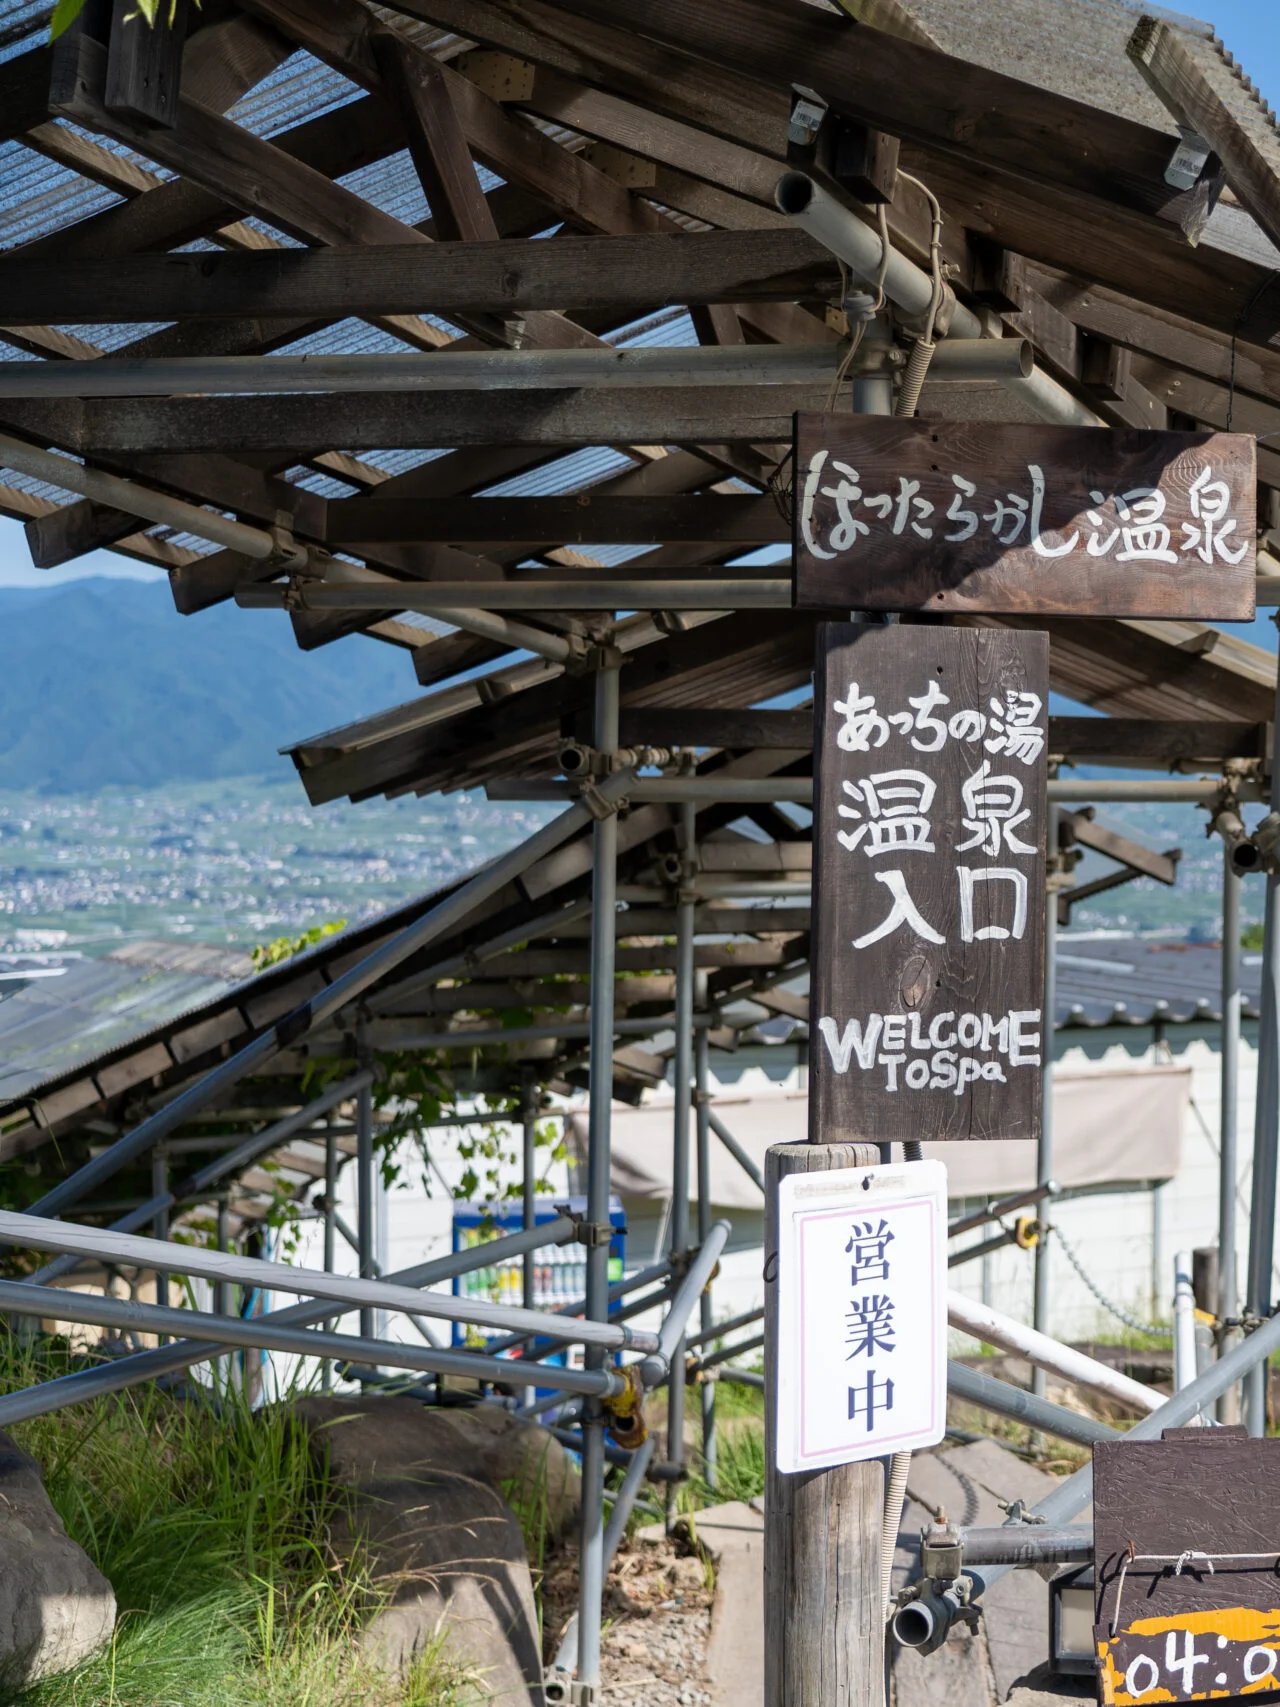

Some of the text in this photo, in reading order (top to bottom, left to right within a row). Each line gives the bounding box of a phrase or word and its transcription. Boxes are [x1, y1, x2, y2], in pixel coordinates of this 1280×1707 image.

[801, 450, 1249, 565] ほったらかし温泉
[834, 680, 1045, 765] あっちの湯
[837, 759, 1039, 858] 温泉
[852, 866, 1029, 950] 入口
[818, 1008, 1041, 1074] WELCOME
[845, 1219, 896, 1432] 営業中
